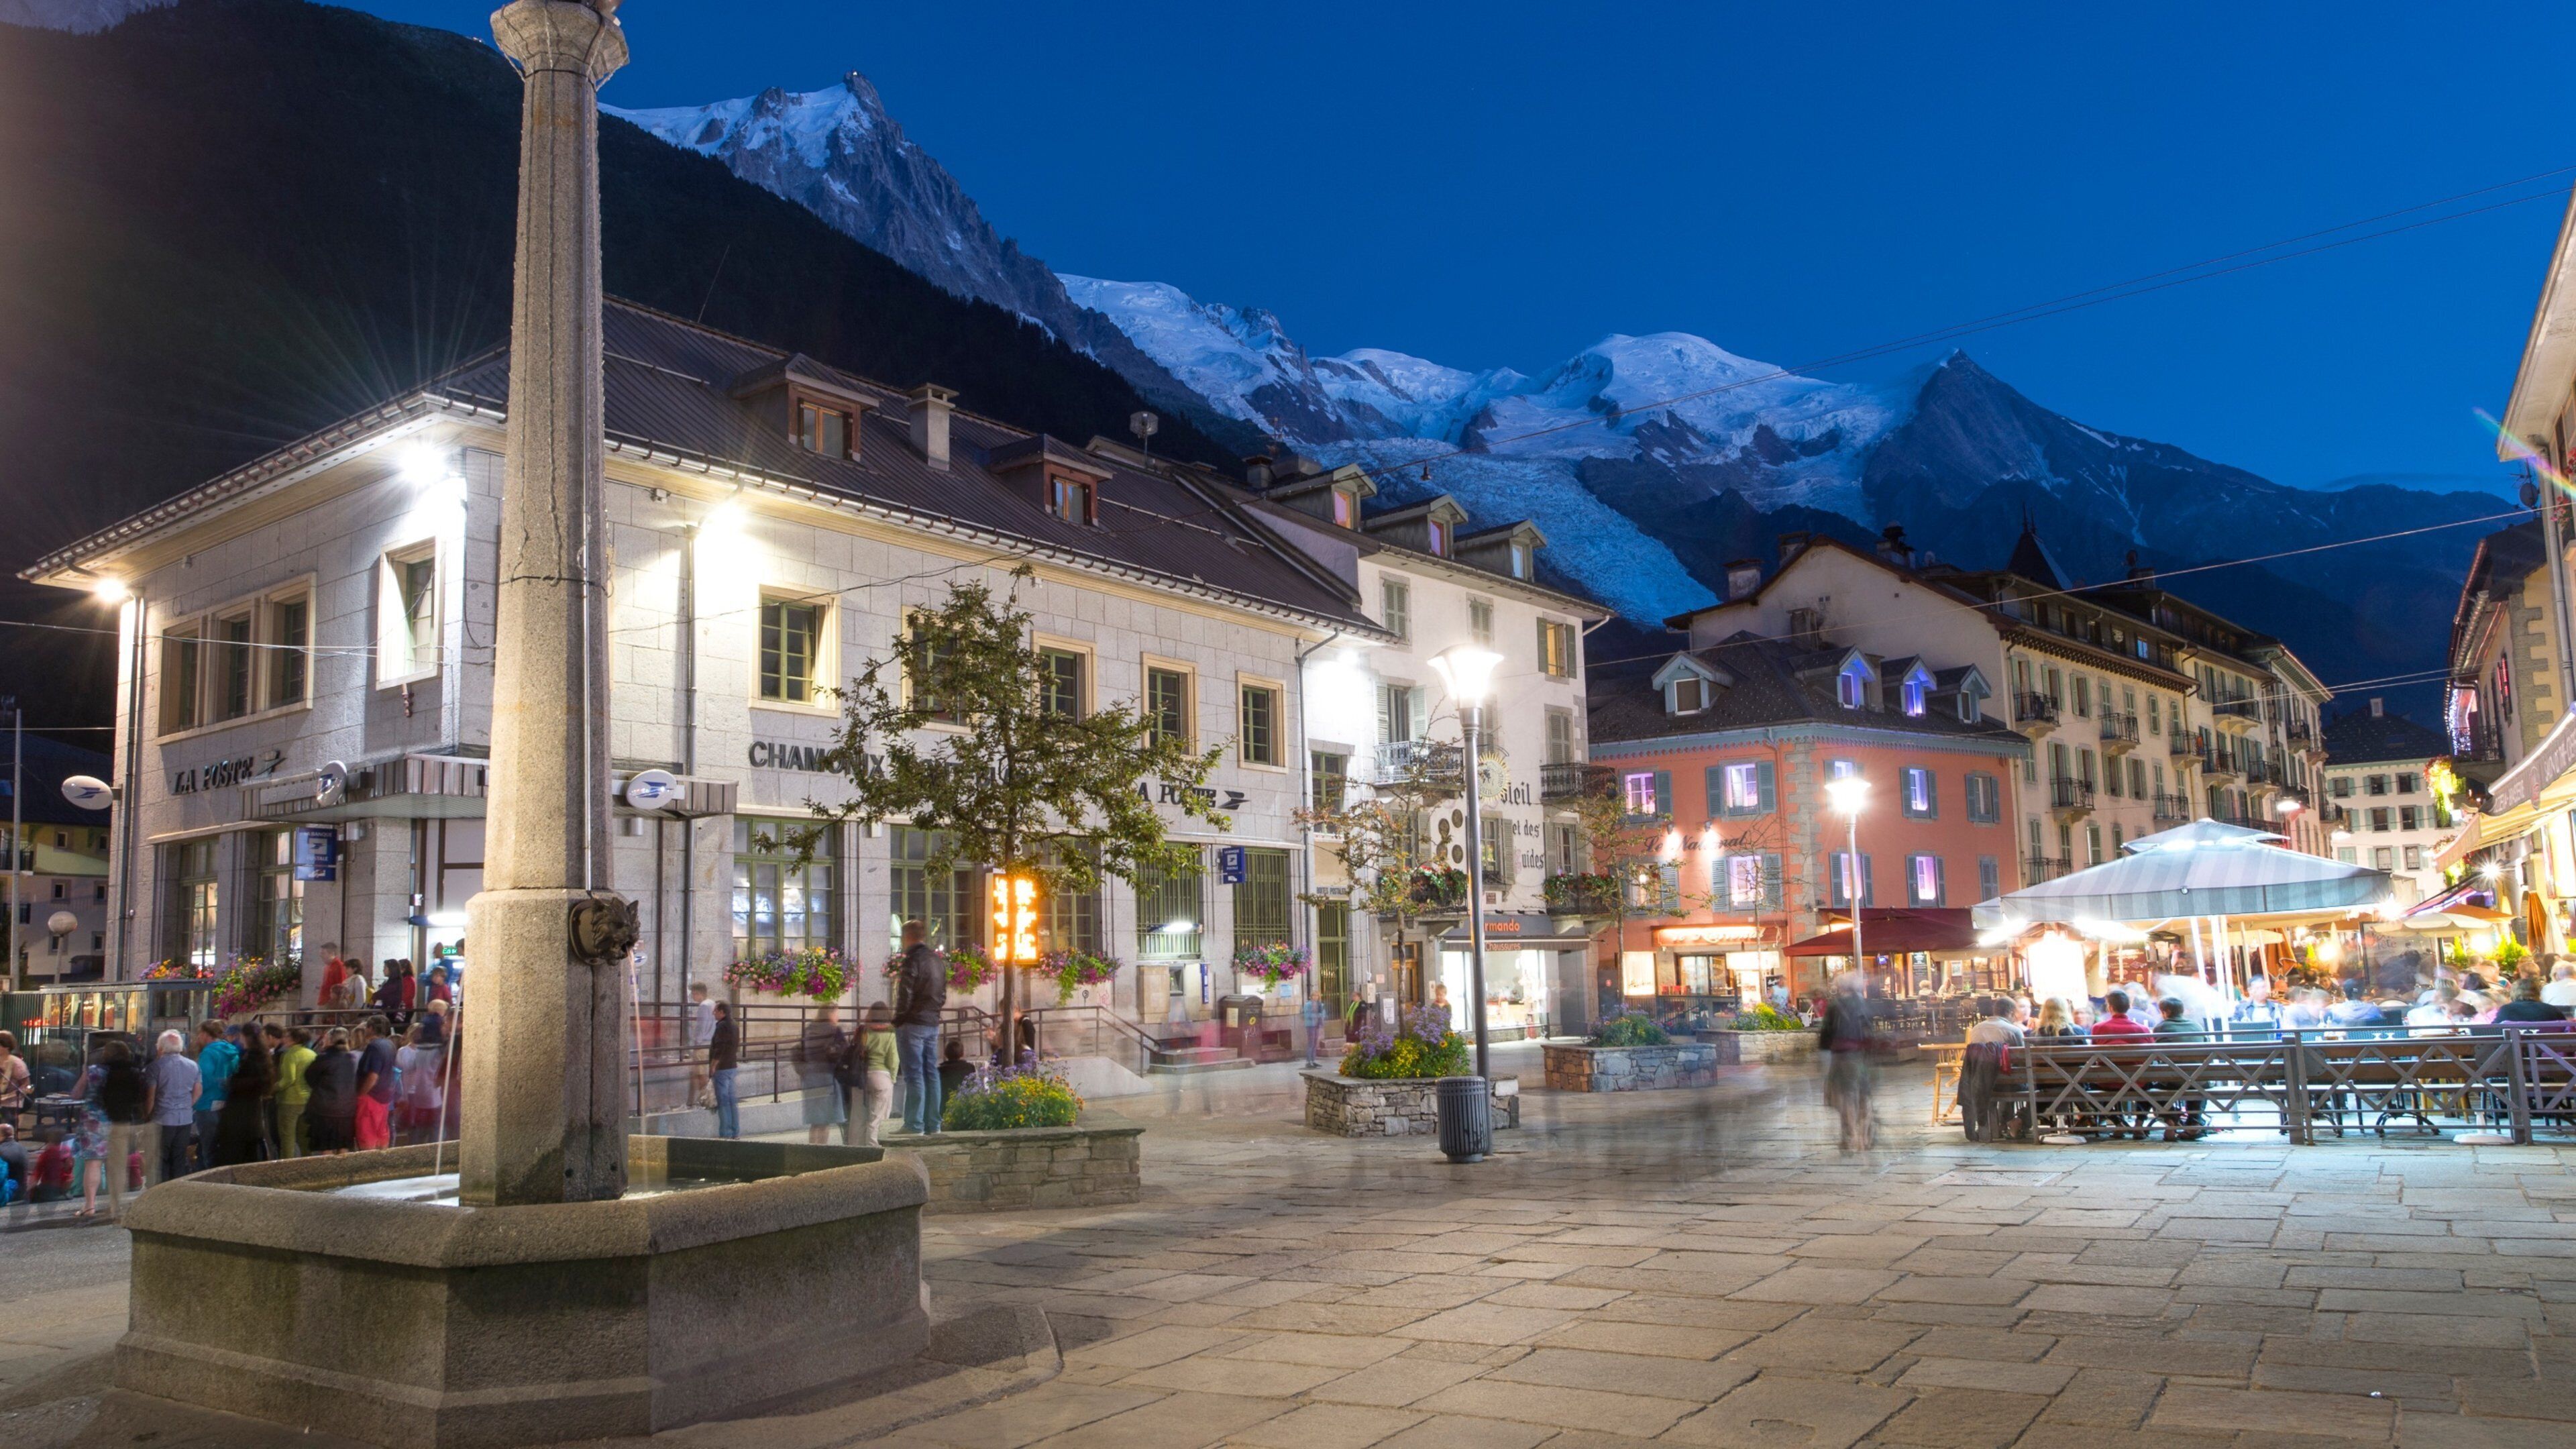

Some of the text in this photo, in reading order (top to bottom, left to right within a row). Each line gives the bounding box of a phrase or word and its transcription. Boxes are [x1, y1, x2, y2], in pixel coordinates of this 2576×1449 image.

[172, 757, 253, 796] LA POSTE
[1512, 819, 1540, 838] et des
[1485, 943, 1521, 951] Chaussures
